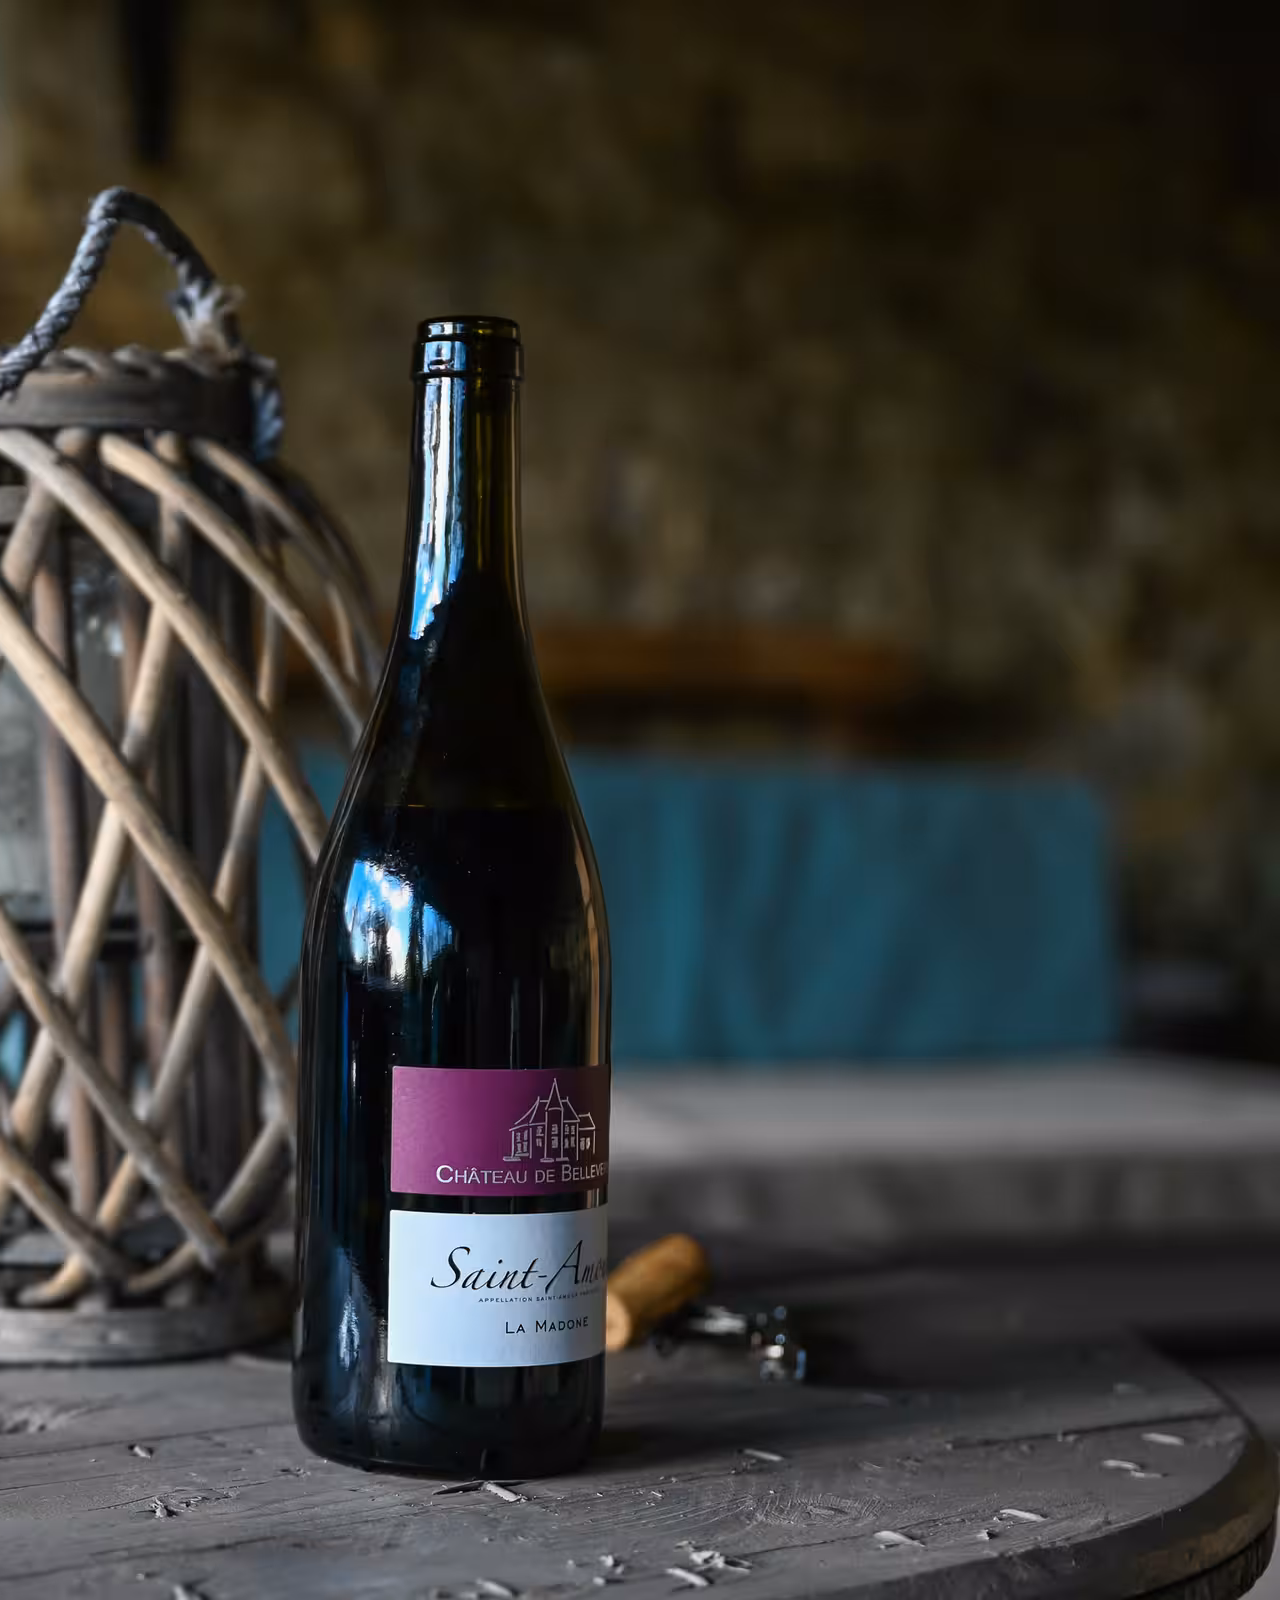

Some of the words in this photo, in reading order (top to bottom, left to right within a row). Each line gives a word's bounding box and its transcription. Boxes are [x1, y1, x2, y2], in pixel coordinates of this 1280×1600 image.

[435, 1164, 527, 1184] CHÂTEAU
[535, 1169, 556, 1183] DE
[561, 1161, 608, 1182] BELLEVE
